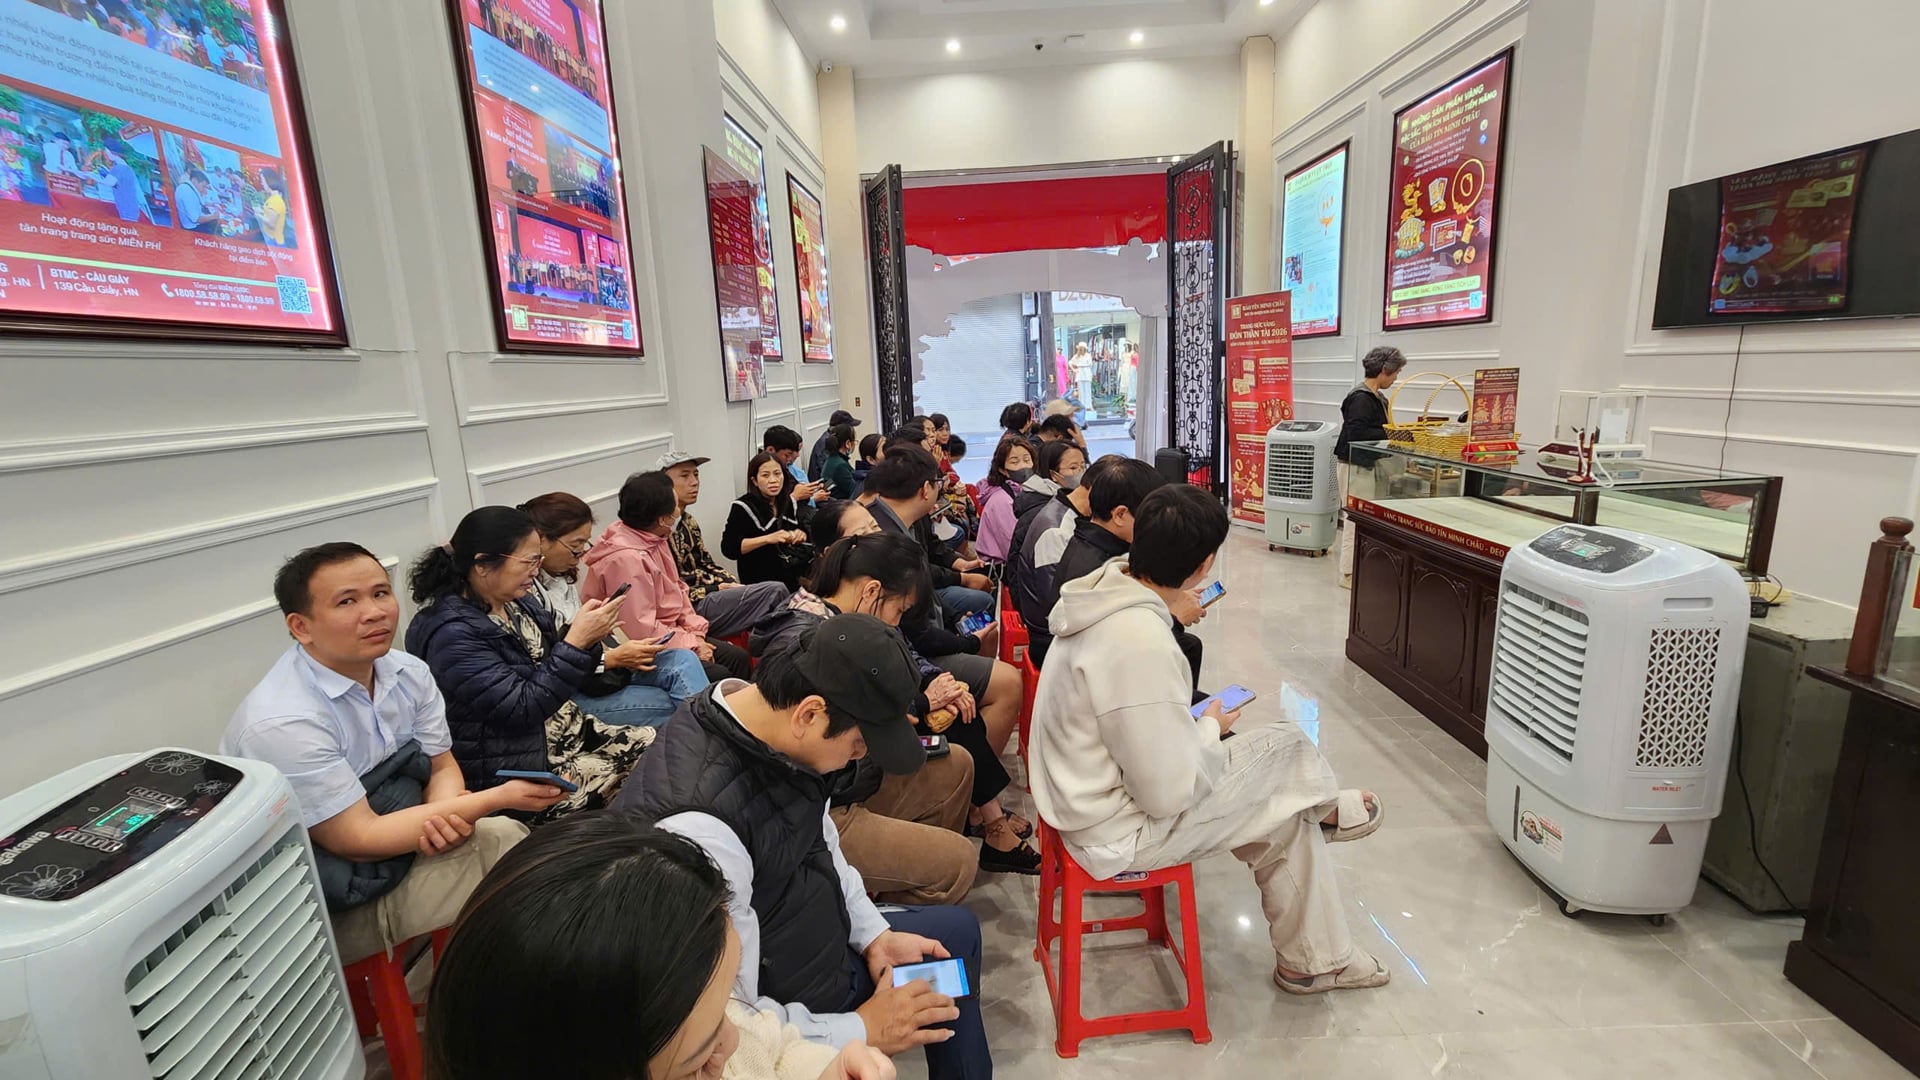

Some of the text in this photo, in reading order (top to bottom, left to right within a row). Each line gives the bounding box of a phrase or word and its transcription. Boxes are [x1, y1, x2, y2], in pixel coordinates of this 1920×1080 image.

[1464, 84, 1484, 100] VÀNG
[41, 212, 67, 226] Hoạt
[69, 217, 96, 231] động
[97, 222, 118, 234] tặng
[40, 225, 68, 240] trang
[71, 230, 96, 244] trang
[98, 234, 116, 245] sức
[118, 235, 144, 248] MIỄN
[145, 240, 162, 250] PHÍ
[50, 268, 78, 279] BTMC
[86, 270, 106, 282] CẦU
[108, 272, 130, 285] GIẤY
[54, 281, 74, 292] 139
[74, 280, 96, 293] Cầu
[124, 287, 140, 296] HN
[1230, 330, 1242, 340] ĐÓN
[1244, 328, 1260, 338] THẦN
[1261, 328, 1270, 336] TÀI
[1384, 512, 1397, 521] VÀNG
[1398, 516, 1414, 528] TRANG
[1414, 519, 1424, 530] SỨC
[1425, 524, 1436, 534] BẢO
[1437, 527, 1447, 538] TÍN
[1448, 532, 1465, 544] MINH
[1466, 536, 1484, 550] CHÂU
